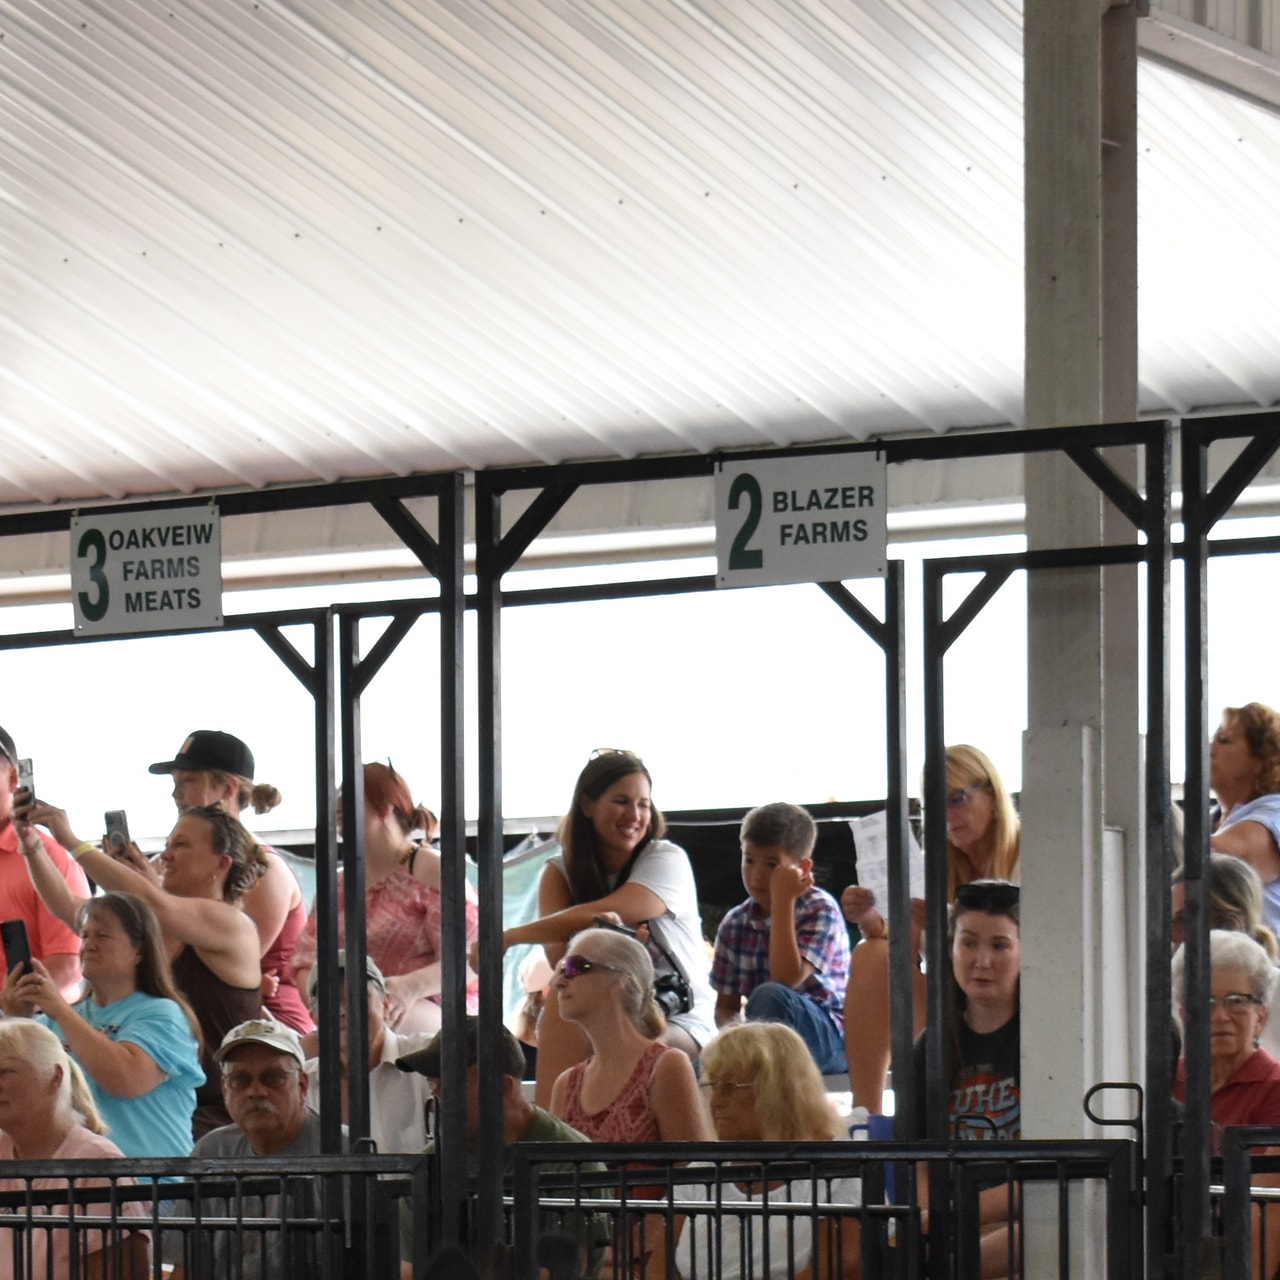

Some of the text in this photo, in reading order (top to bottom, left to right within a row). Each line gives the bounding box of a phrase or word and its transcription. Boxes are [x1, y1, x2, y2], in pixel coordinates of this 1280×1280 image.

[773, 485, 875, 513] BLAZER
[727, 472, 763, 571] 2
[780, 519, 868, 546] FARMS
[108, 523, 213, 550] OAKVEIW
[77, 528, 110, 623] 3
[122, 555, 200, 581] FARMS
[125, 587, 201, 613] MEATS
